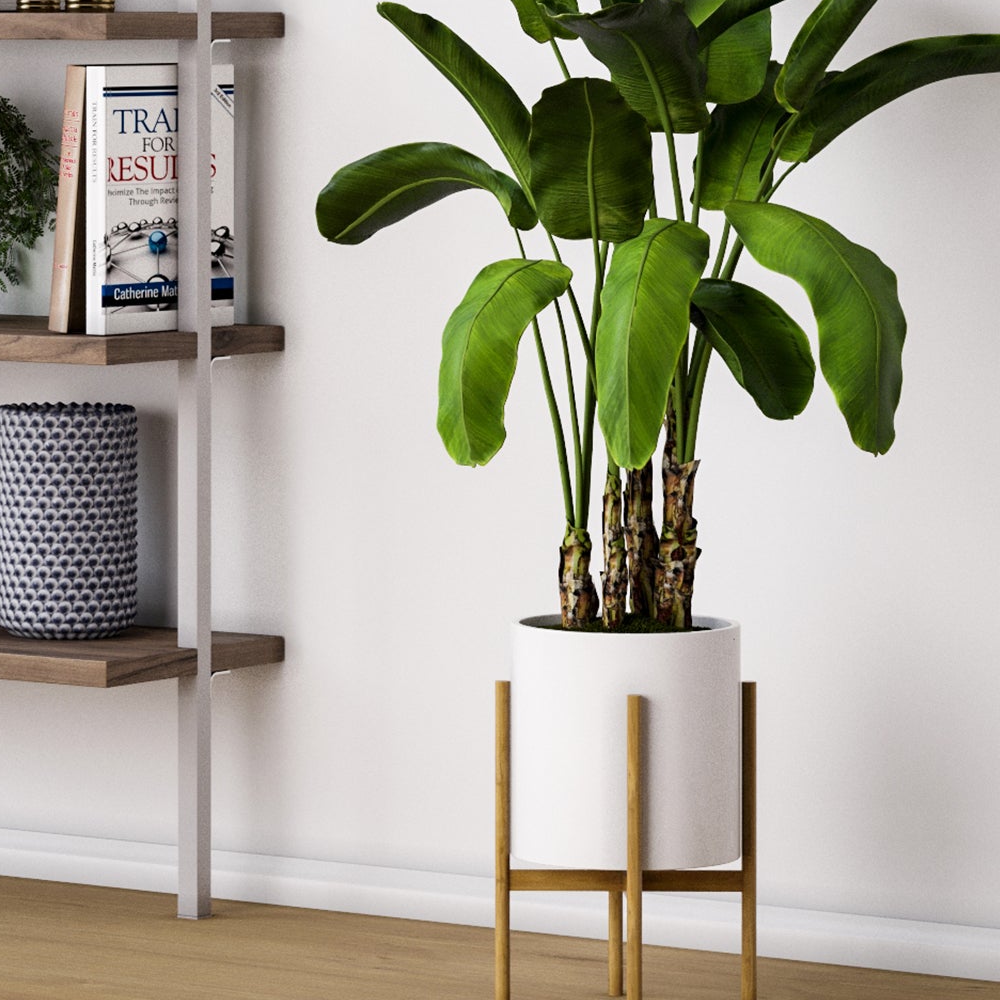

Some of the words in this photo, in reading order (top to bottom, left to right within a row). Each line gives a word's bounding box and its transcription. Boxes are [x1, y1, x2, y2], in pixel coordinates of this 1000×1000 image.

[113, 108, 178, 134] TRAI
[142, 137, 175, 152] FOR
[129, 198, 158, 206] Through
[113, 284, 159, 301] Catherine
[161, 283, 178, 297] Mat
